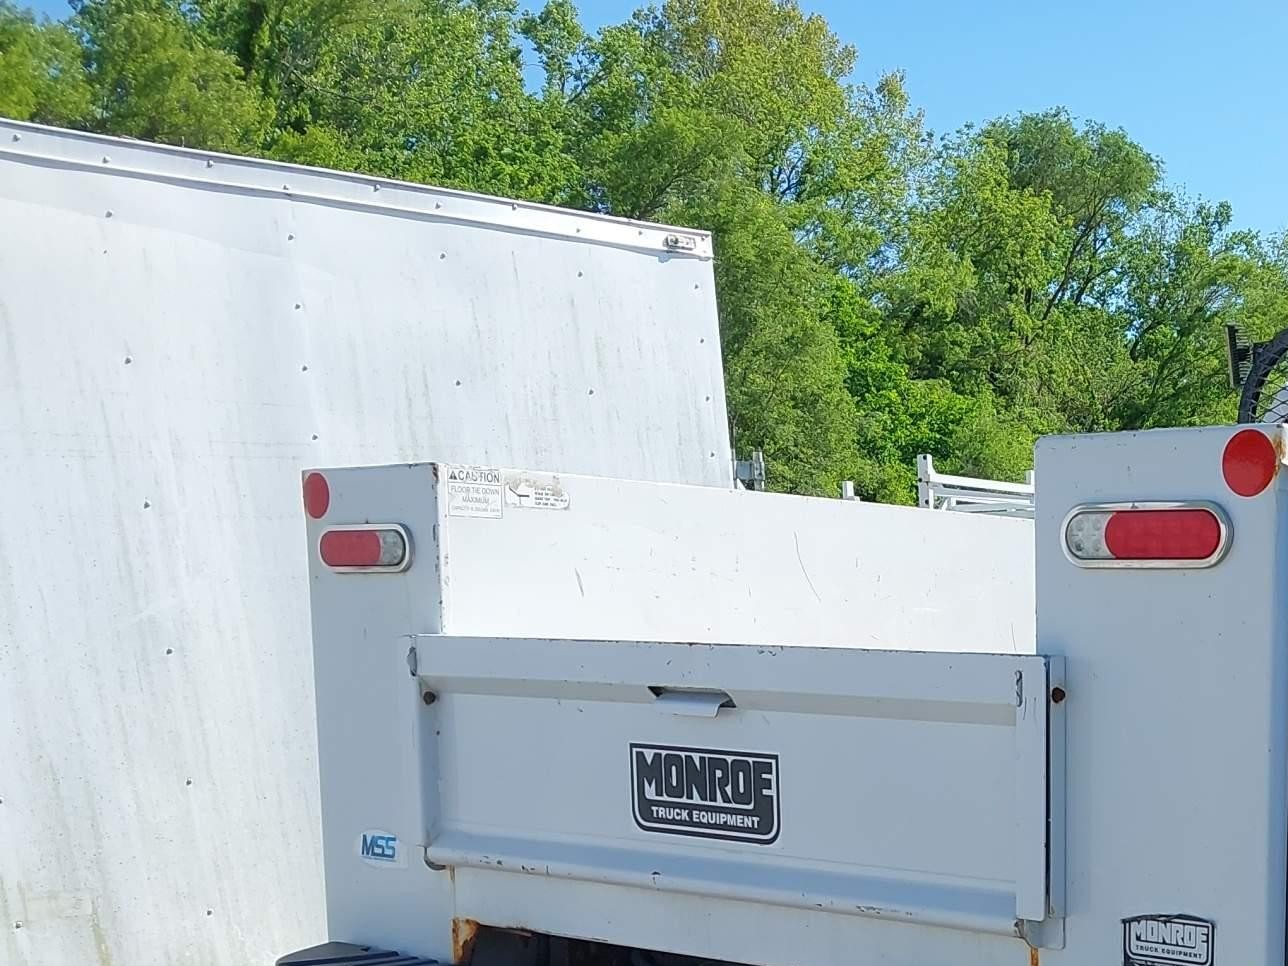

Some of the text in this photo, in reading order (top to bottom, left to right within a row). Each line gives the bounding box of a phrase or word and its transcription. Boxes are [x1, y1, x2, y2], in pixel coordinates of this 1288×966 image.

[458, 471, 500, 483] CAUTION
[635, 750, 774, 806] MONROE
[651, 806, 760, 829] TRUCK EQUIPMENT
[1130, 919, 1209, 947] MONROE
[1135, 944, 1203, 959] TRUCK EQUIPMENT
